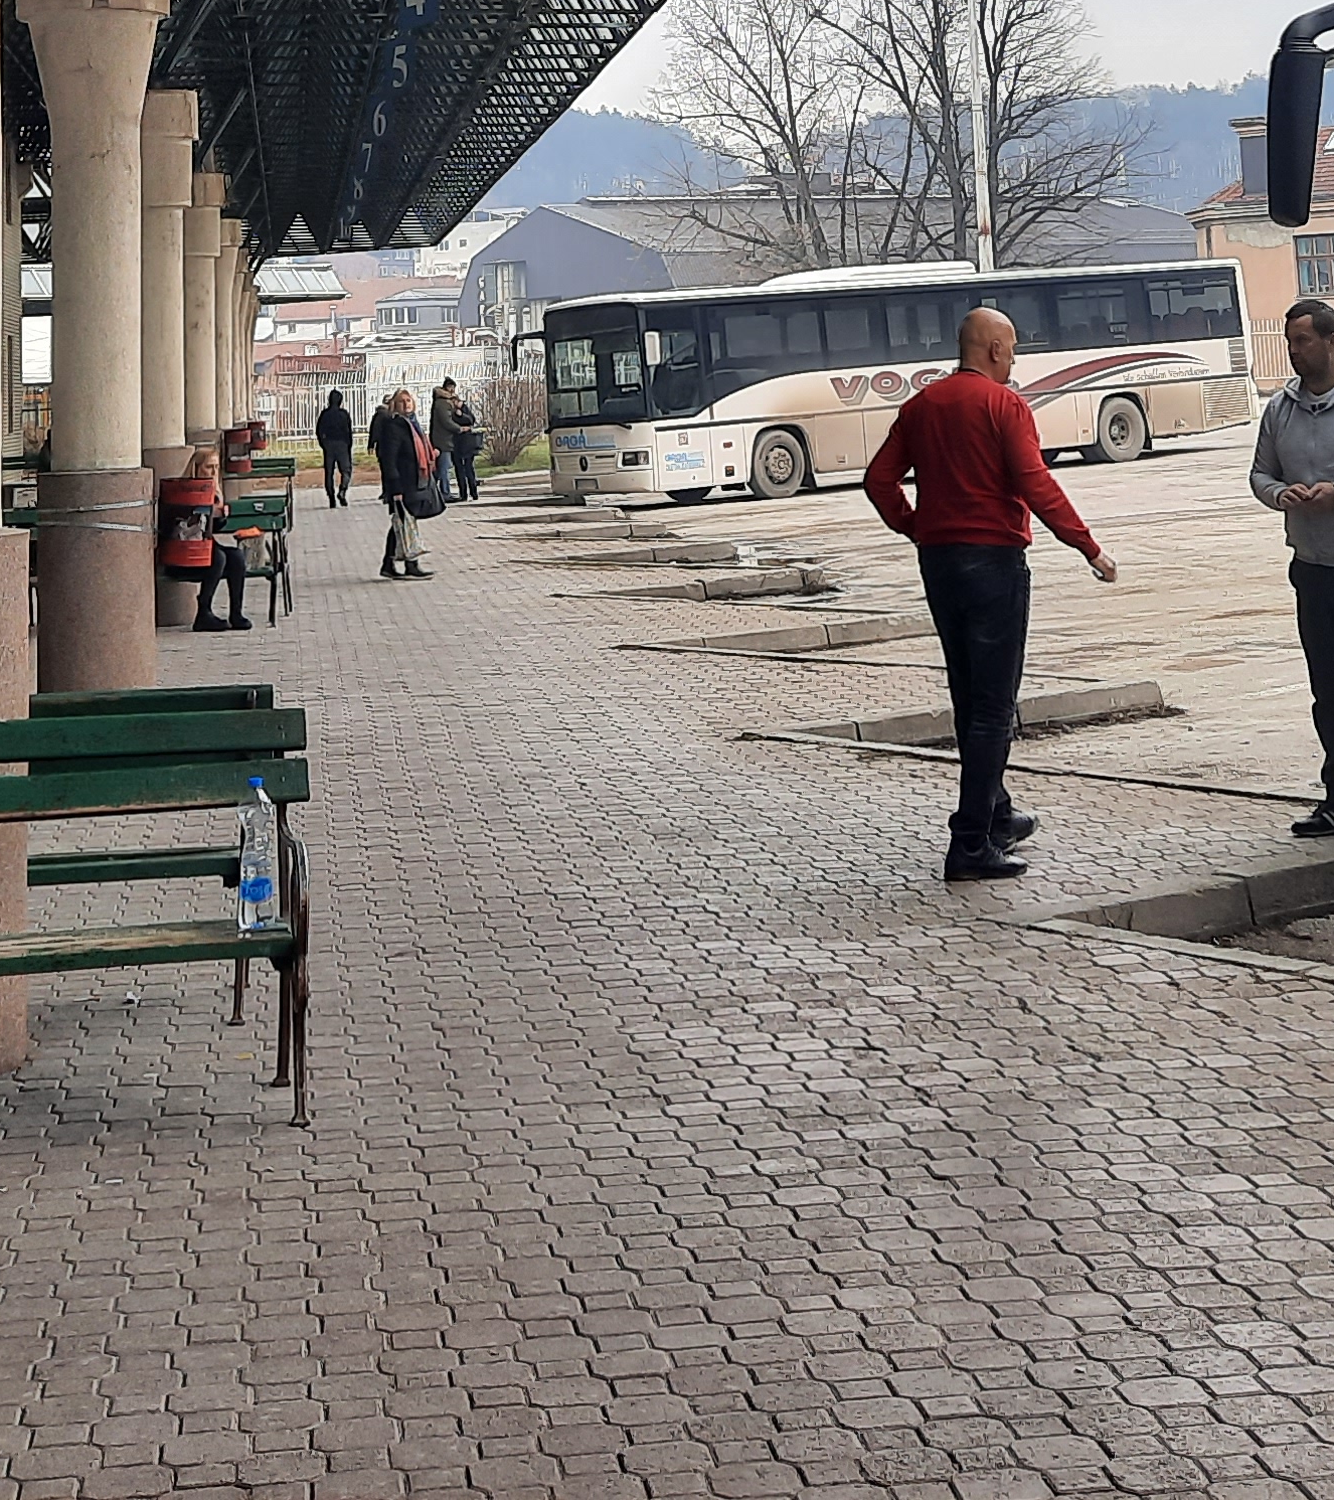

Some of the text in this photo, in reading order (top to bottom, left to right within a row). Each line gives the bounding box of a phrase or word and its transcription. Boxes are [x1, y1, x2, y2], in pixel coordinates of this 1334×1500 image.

[392, 41, 409, 89] 5
[372, 100, 387, 137] 6
[361, 142, 373, 173] 7
[353, 177, 364, 200] 8
